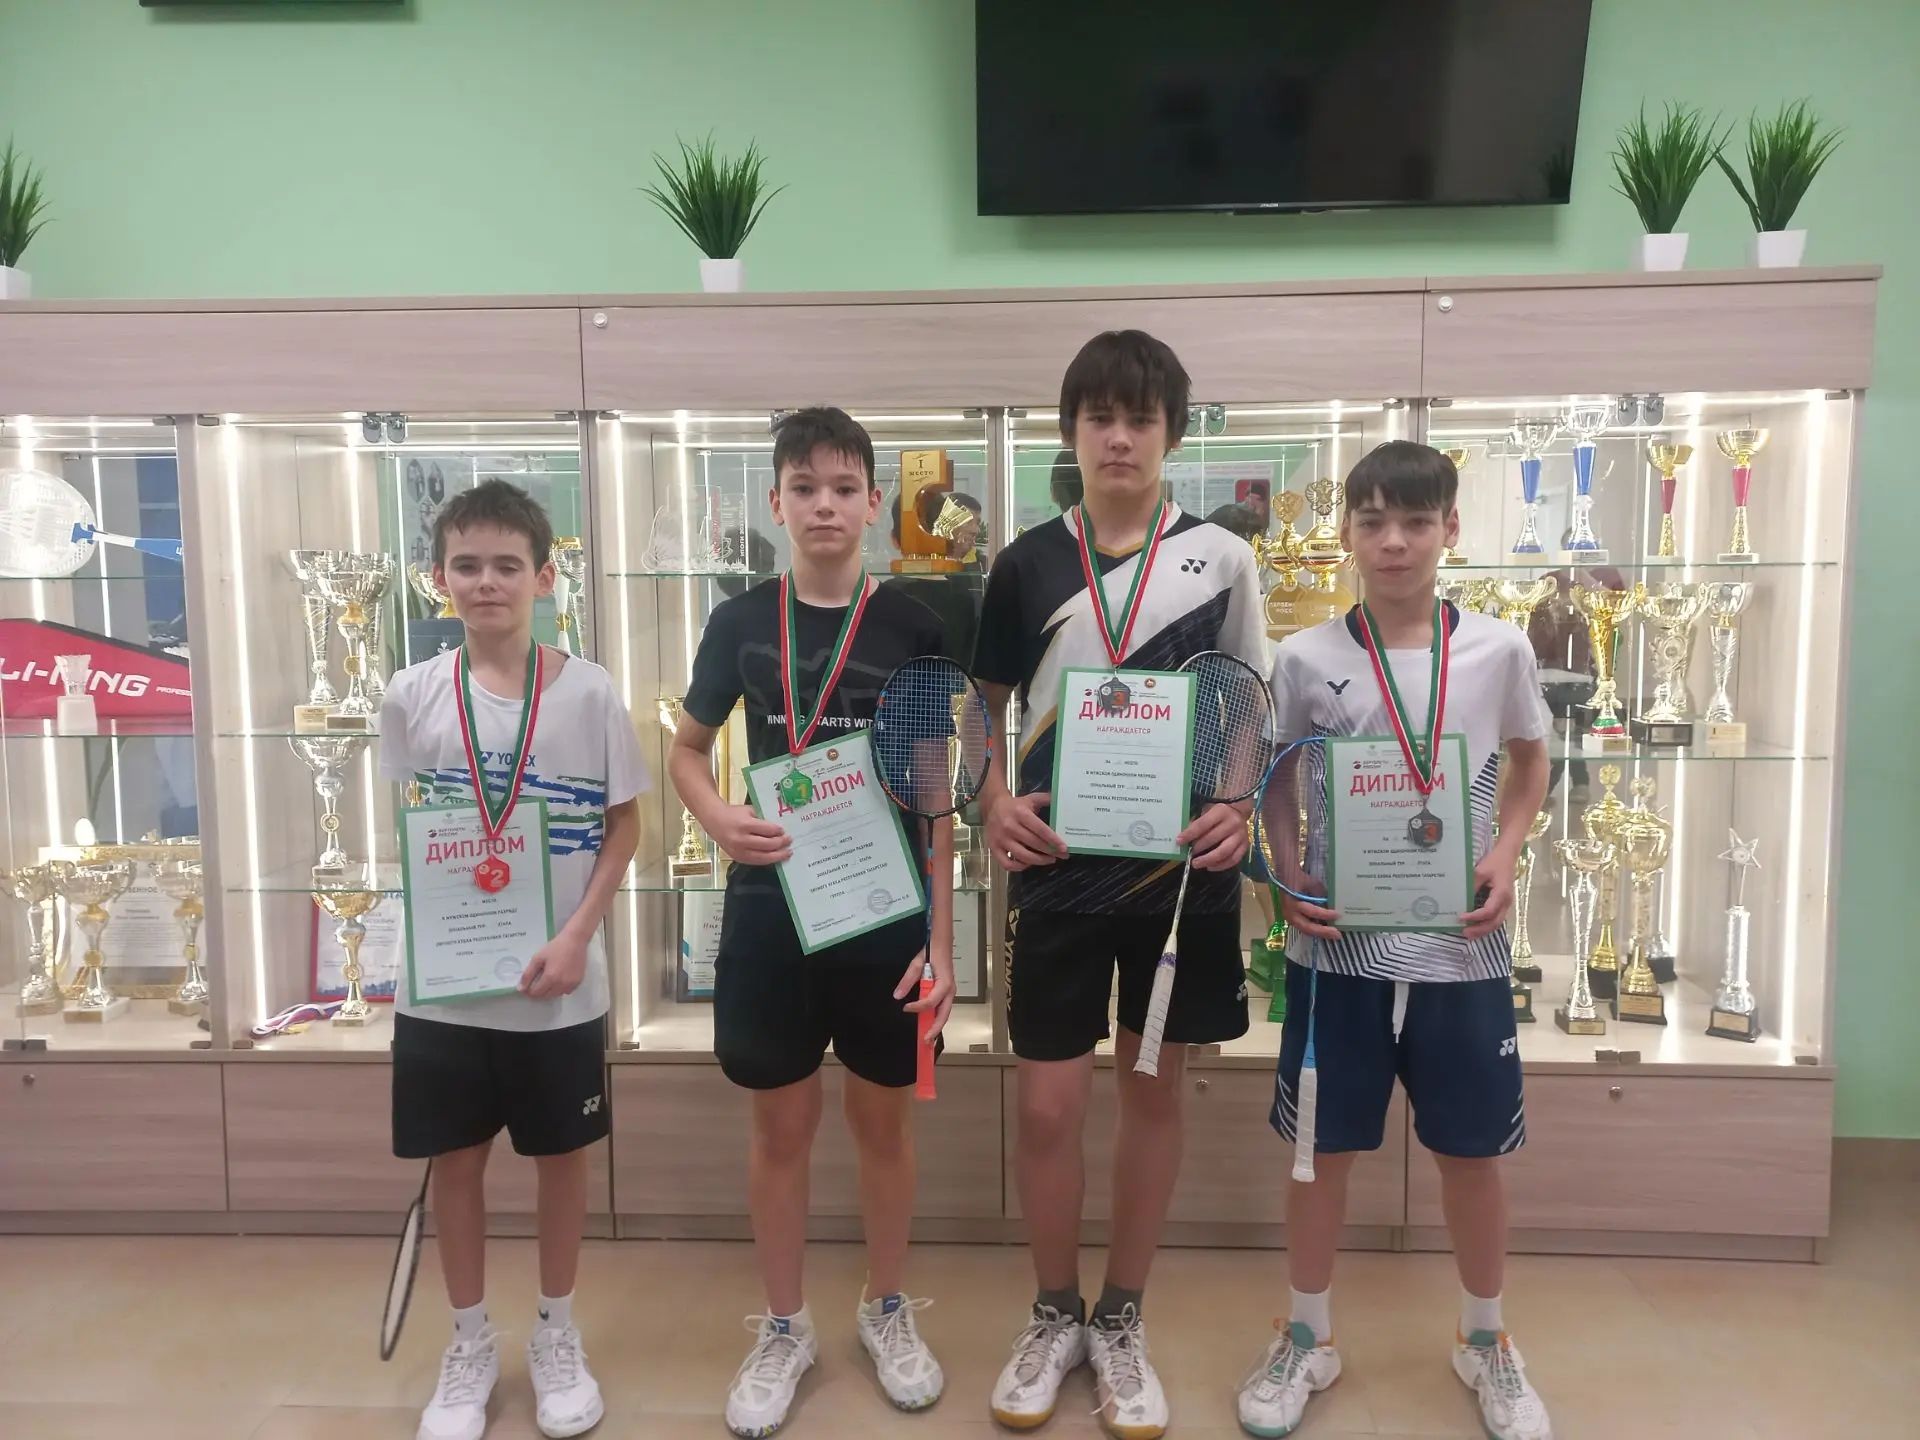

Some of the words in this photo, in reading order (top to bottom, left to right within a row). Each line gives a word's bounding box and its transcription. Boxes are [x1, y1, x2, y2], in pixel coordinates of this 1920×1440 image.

[817, 715, 851, 728] TARTS
[1096, 726, 1151, 735] НАГРАЖДАЕТСЯ
[497, 752, 536, 767] YOX
[1350, 773, 1446, 797] ДИПЛМ
[801, 801, 853, 823] НАГРАЖДАЕТСЯ
[490, 869, 505, 887] 2
